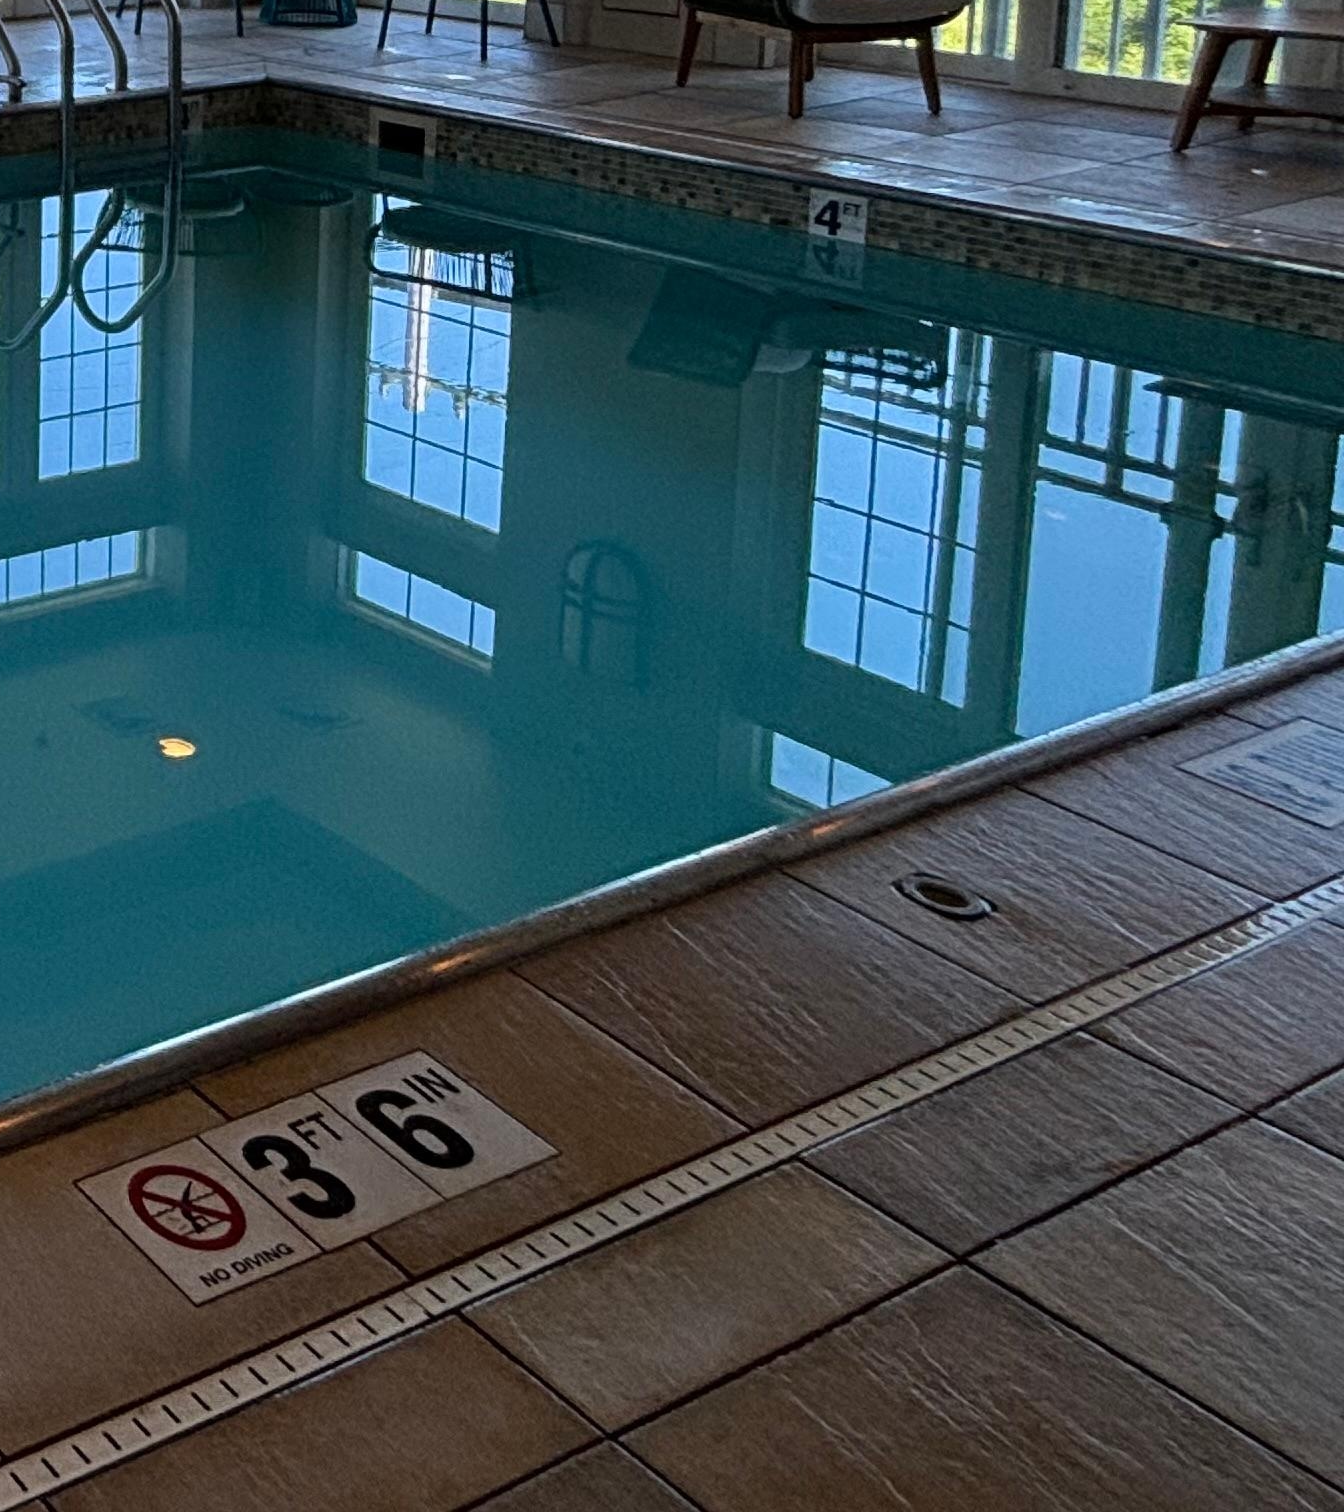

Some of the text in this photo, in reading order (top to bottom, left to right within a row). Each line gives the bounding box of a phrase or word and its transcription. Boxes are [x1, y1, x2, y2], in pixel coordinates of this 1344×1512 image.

[814, 199, 861, 235] 4 FT
[242, 1068, 474, 1219] 3 FT 6 IN
[199, 1242, 295, 1288] NO DIVING
